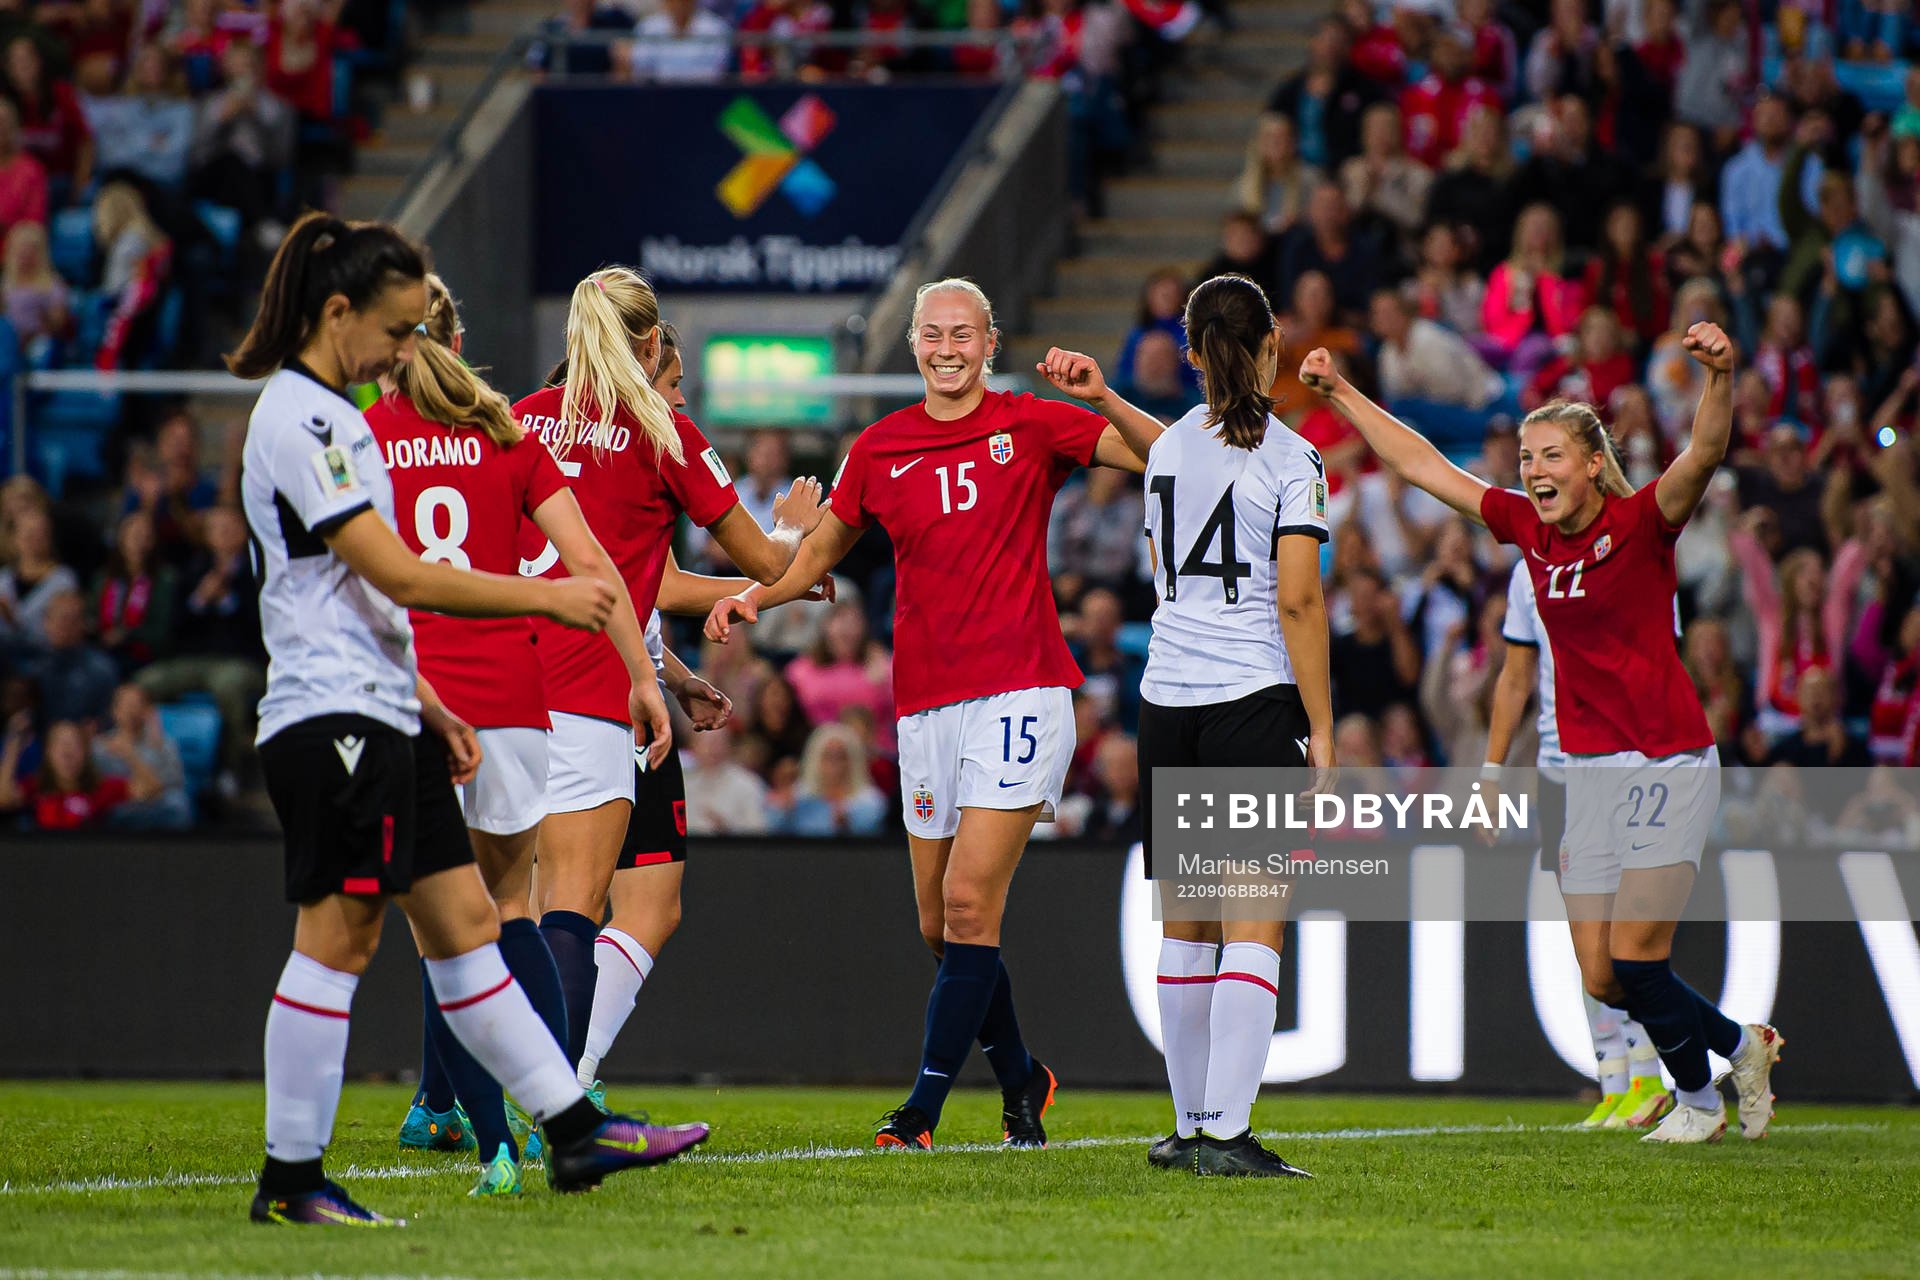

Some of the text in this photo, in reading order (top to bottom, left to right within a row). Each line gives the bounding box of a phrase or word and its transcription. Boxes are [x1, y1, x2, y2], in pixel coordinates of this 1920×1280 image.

[385, 436, 481, 470] JORAMO
[935, 461, 978, 514] 15
[415, 486, 471, 572] 8
[1150, 475, 1251, 605] 14
[1545, 559, 1586, 598] 22
[1000, 716, 1037, 764] 15
[1627, 782, 1669, 827] 22
